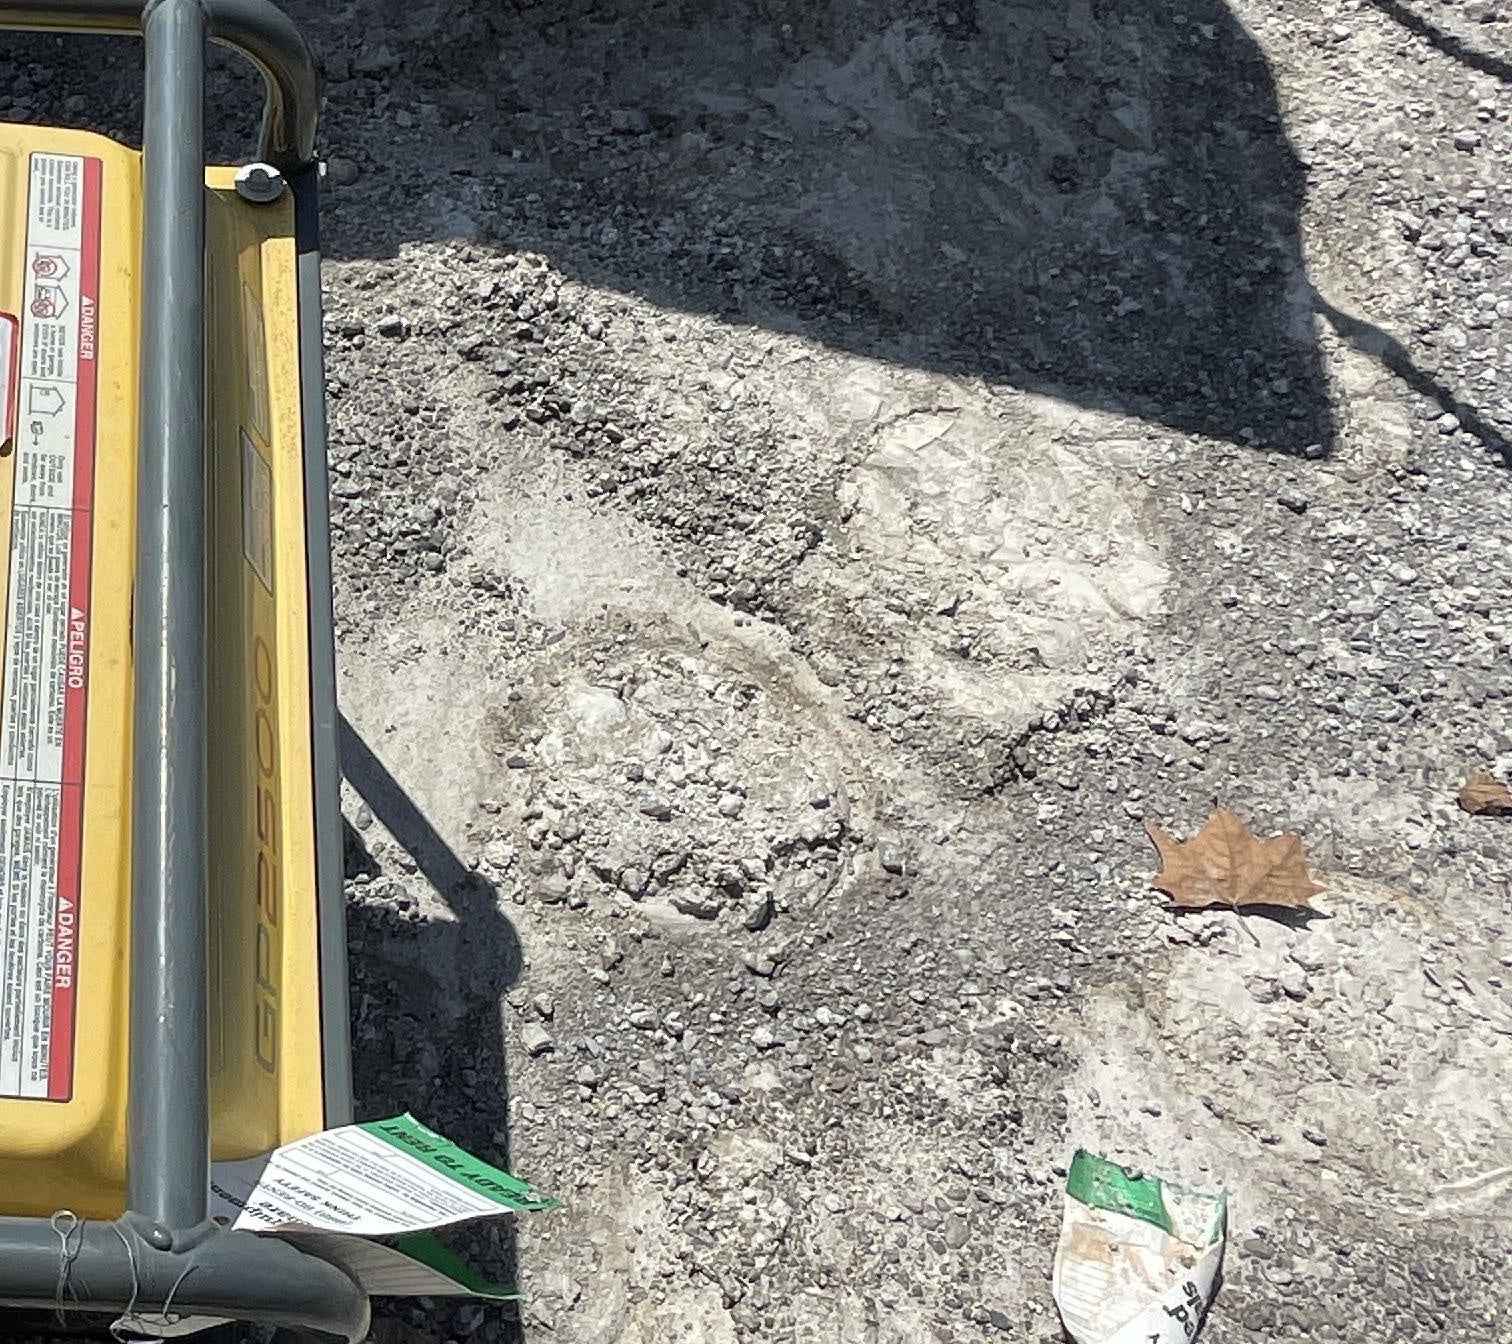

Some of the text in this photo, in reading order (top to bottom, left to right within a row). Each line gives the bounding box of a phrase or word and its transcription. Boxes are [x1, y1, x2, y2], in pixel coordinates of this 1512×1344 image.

[80, 307, 95, 360] DANGER
[68, 620, 85, 689] PELIGRO
[254, 636, 278, 1075] GP2500
[55, 912, 73, 988] DANGER
